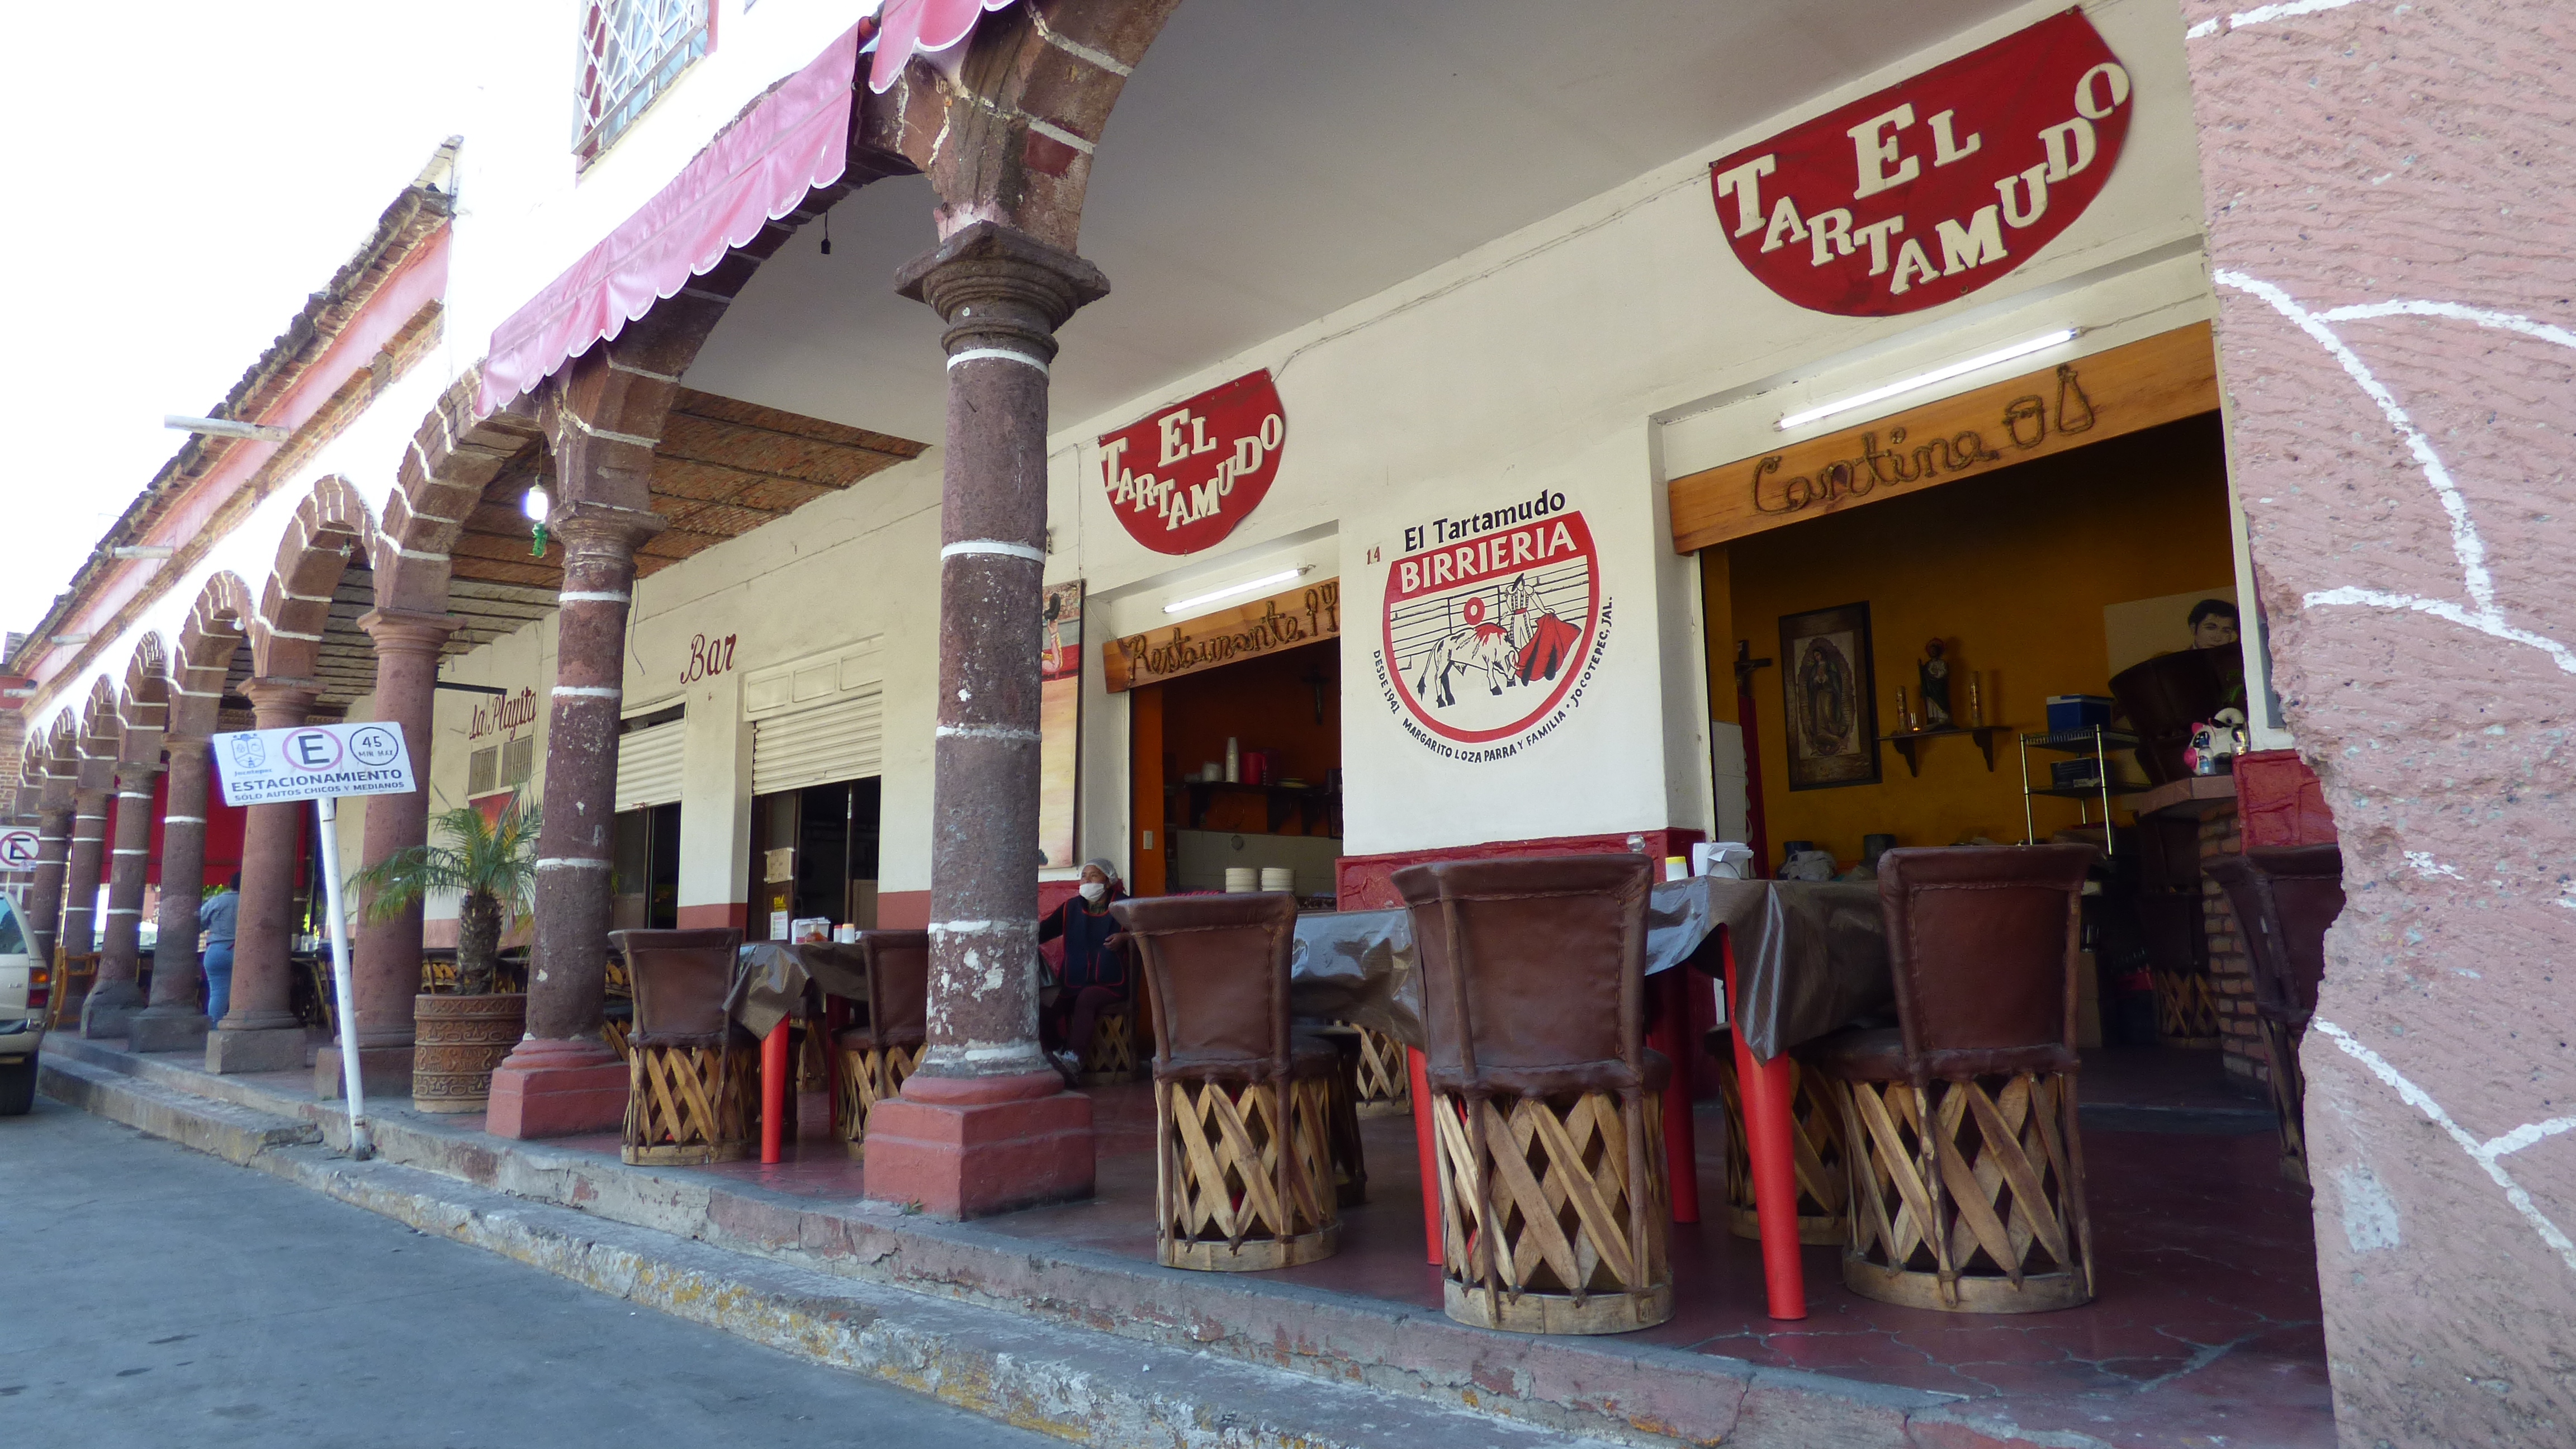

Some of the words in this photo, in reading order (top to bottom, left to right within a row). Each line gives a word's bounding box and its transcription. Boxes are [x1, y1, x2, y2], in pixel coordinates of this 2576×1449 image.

[1717, 62, 2130, 295] TARTAMUDO
[1846, 102, 1981, 200] EL
[1158, 408, 1218, 468] EL
[1099, 413, 1284, 531] TARTAMUDO
[1751, 427, 2000, 515] Cantina
[1404, 524, 1424, 552] El
[1433, 489, 1566, 544] Tartamudo
[1367, 546, 1380, 565] 14
[1400, 521, 1578, 594] BIRRIERIA
[680, 632, 737, 684] Bar
[1120, 600, 1306, 683] Restaurante
[1373, 650, 1389, 689] DESDE
[1384, 687, 1400, 715] 1941
[1402, 717, 1452, 758] MARGARITO
[1455, 749, 1482, 764] LOZA
[1484, 744, 1517, 762] PARRA
[1517, 738, 1523, 750] Y
[1526, 710, 1566, 747] FAMILIA
[1601, 596, 1613, 628] JAL.
[362, 736, 382, 748] 45
[487, 686, 537, 742] Playita
[231, 769, 402, 792] ESTACIONAMIENTO
[298, 734, 330, 765] E
[267, 789, 301, 798] AUTOS
[304, 785, 341, 794] CHICOS
[353, 782, 405, 791] MEDIANOS
